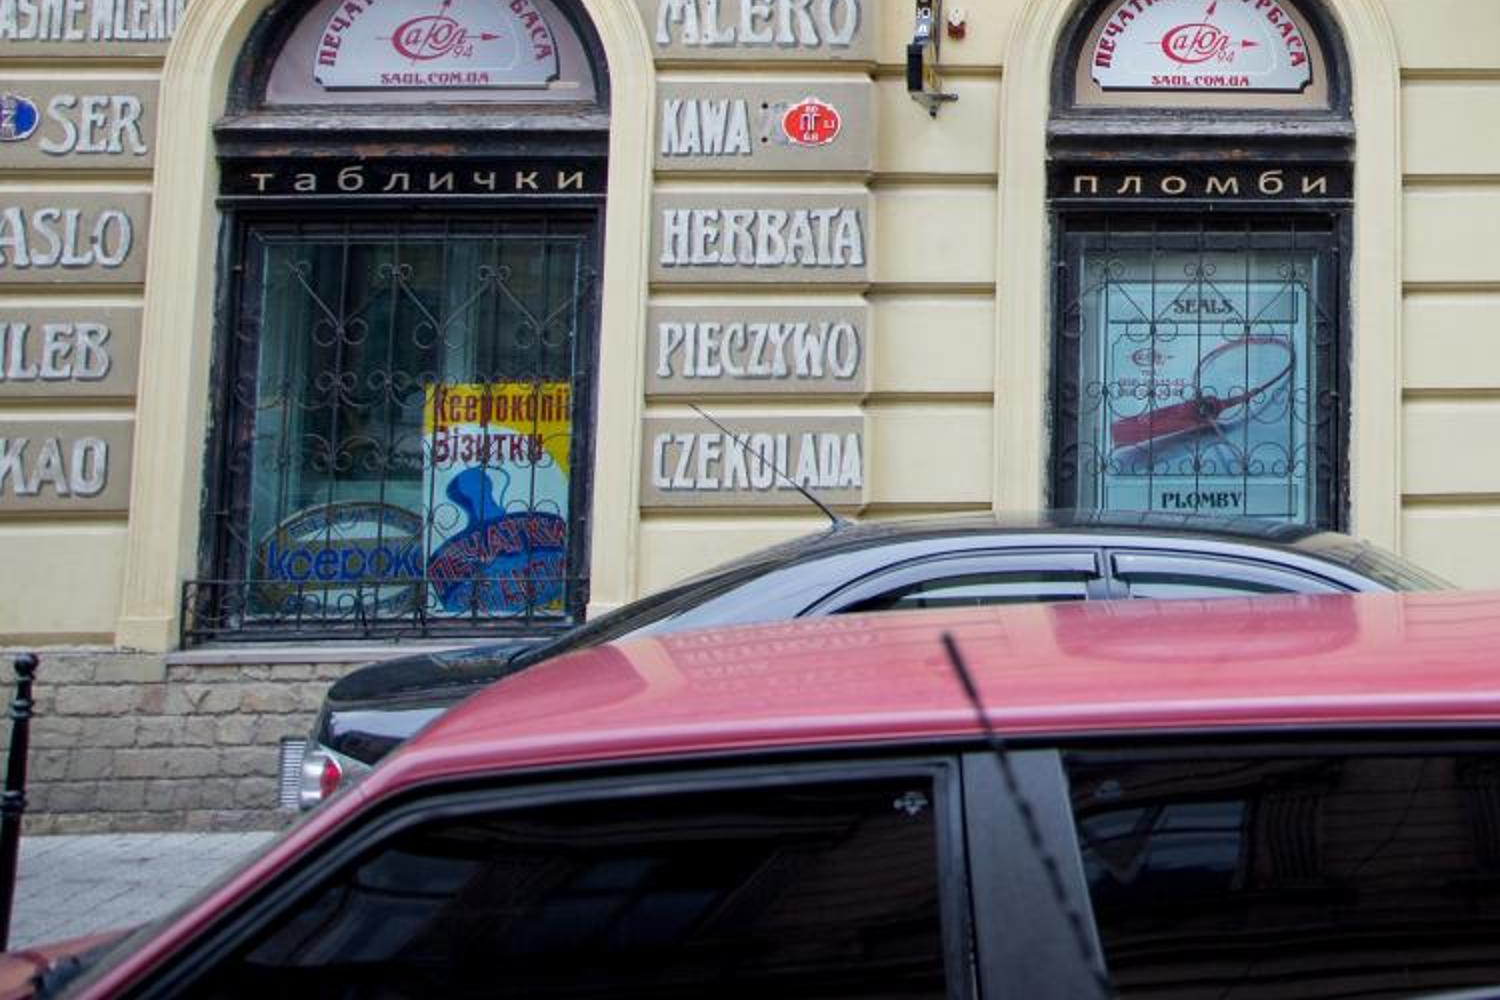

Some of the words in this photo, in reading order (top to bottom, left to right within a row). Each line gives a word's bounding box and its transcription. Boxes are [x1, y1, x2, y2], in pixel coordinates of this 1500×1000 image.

[40, 94, 148, 155] SER
[661, 99, 752, 156] KAWA
[251, 166, 584, 191] таблички
[1073, 170, 1328, 195] пломби
[659, 208, 866, 267] HERBATA
[1173, 299, 1234, 315] SEALS
[655, 321, 863, 379] PIECZYWO
[652, 431, 864, 491] CZEKOLADA
[1162, 491, 1242, 508] PLOMBY
